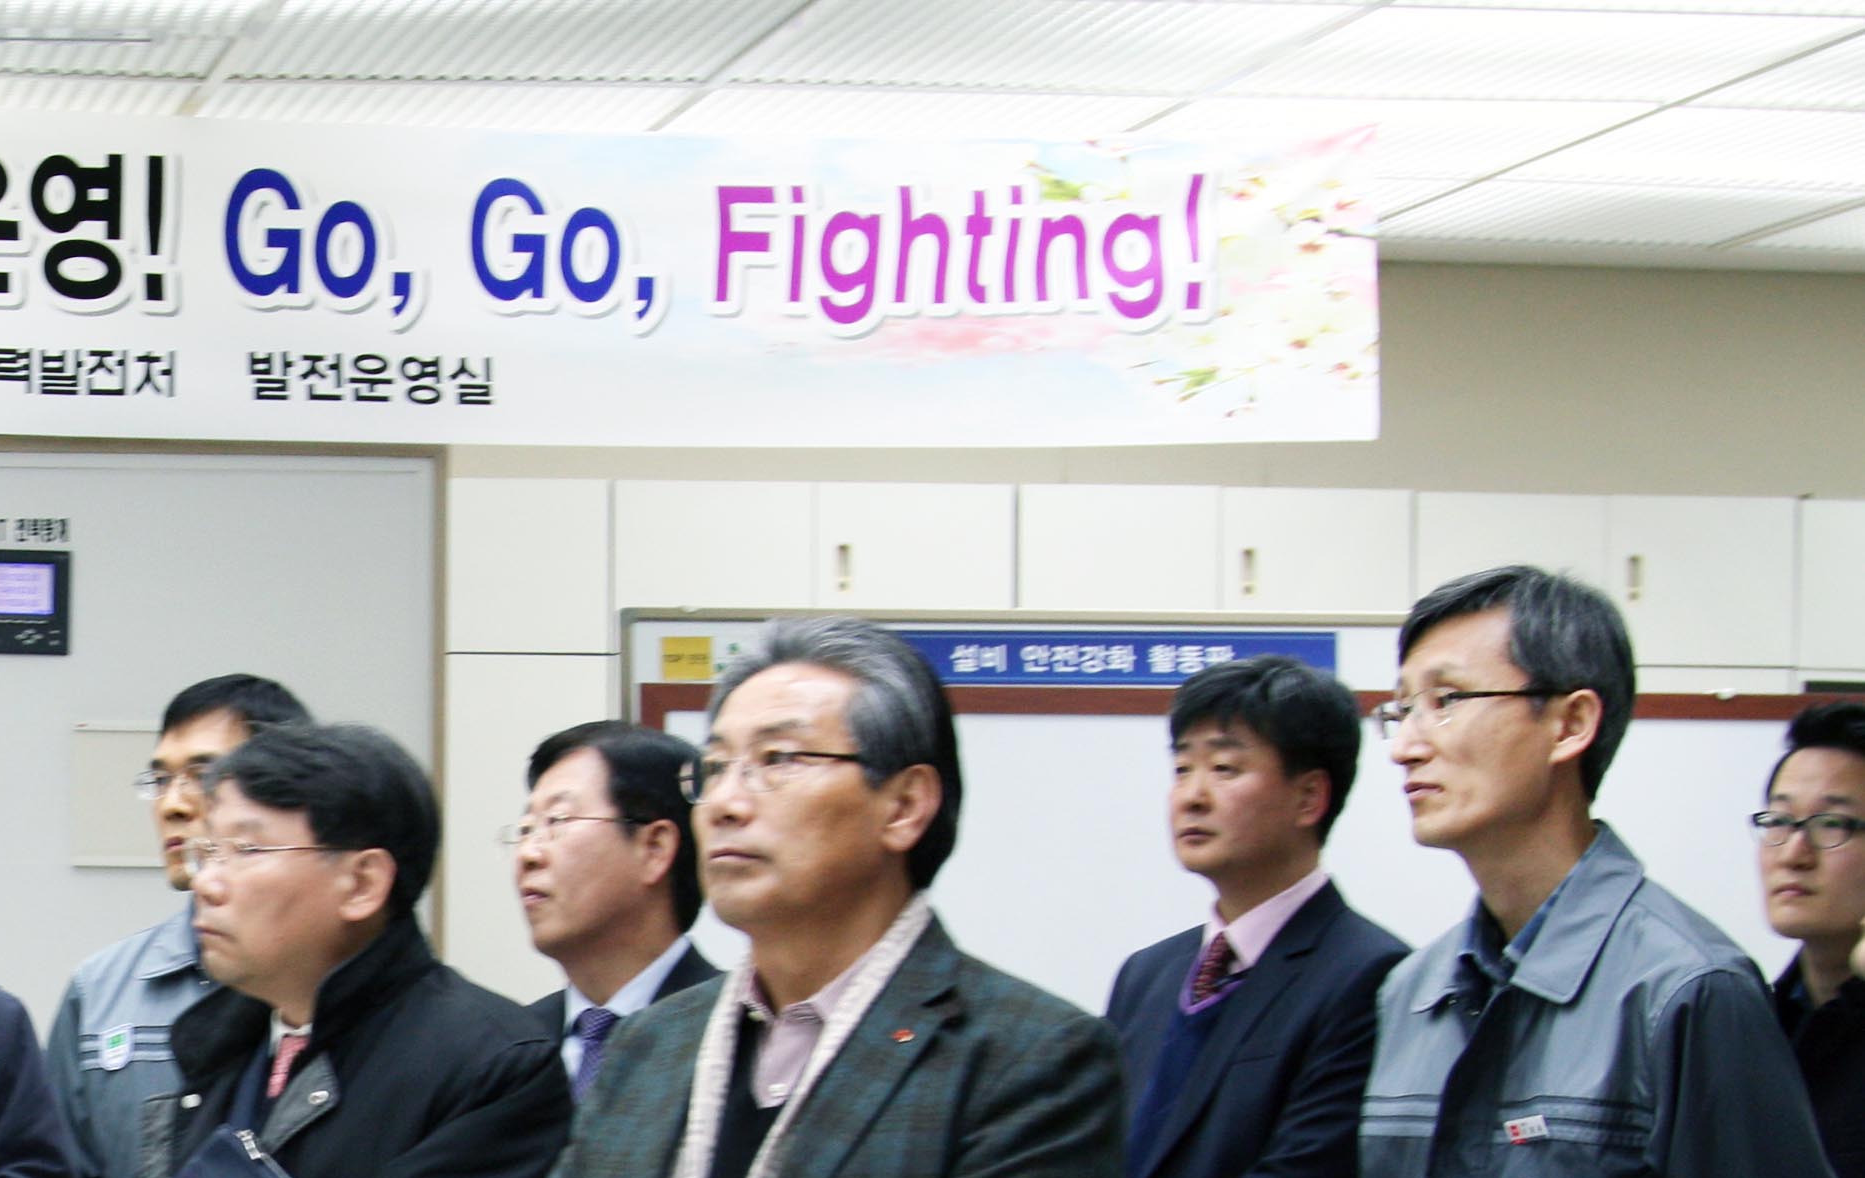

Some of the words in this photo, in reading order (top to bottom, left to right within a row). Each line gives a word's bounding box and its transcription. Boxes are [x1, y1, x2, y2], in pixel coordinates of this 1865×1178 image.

[224, 168, 413, 315] Go,
[470, 177, 655, 320] Go,
[714, 174, 1204, 324] Fighting!
[248, 350, 494, 406] 발전운영실
[949, 644, 1007, 673] 설비
[1020, 644, 1137, 674] 안전강화
